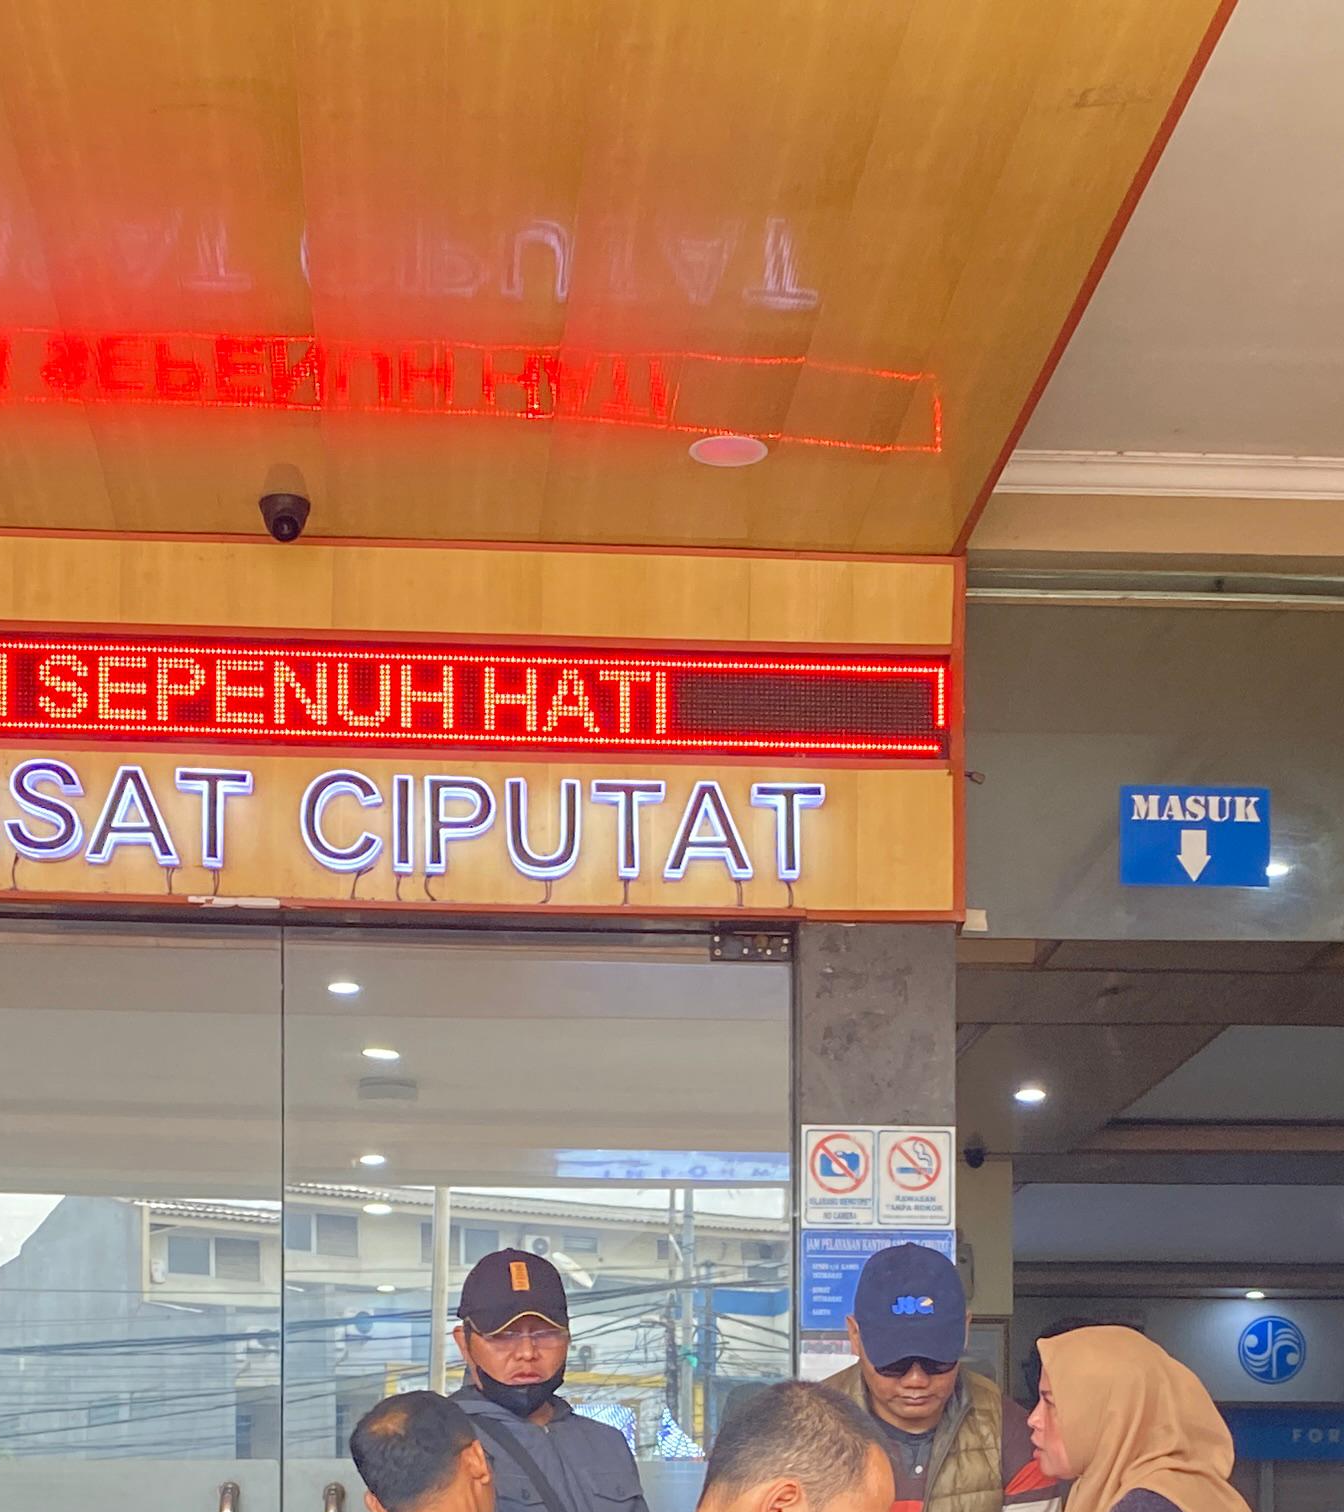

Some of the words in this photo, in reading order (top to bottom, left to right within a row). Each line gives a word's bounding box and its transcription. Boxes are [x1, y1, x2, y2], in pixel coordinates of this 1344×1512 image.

[37, 653, 456, 731] SEPENUH
[483, 664, 668, 735] HATI
[299, 768, 826, 881] CIPUTAT
[1130, 794, 1262, 823] MASUK
